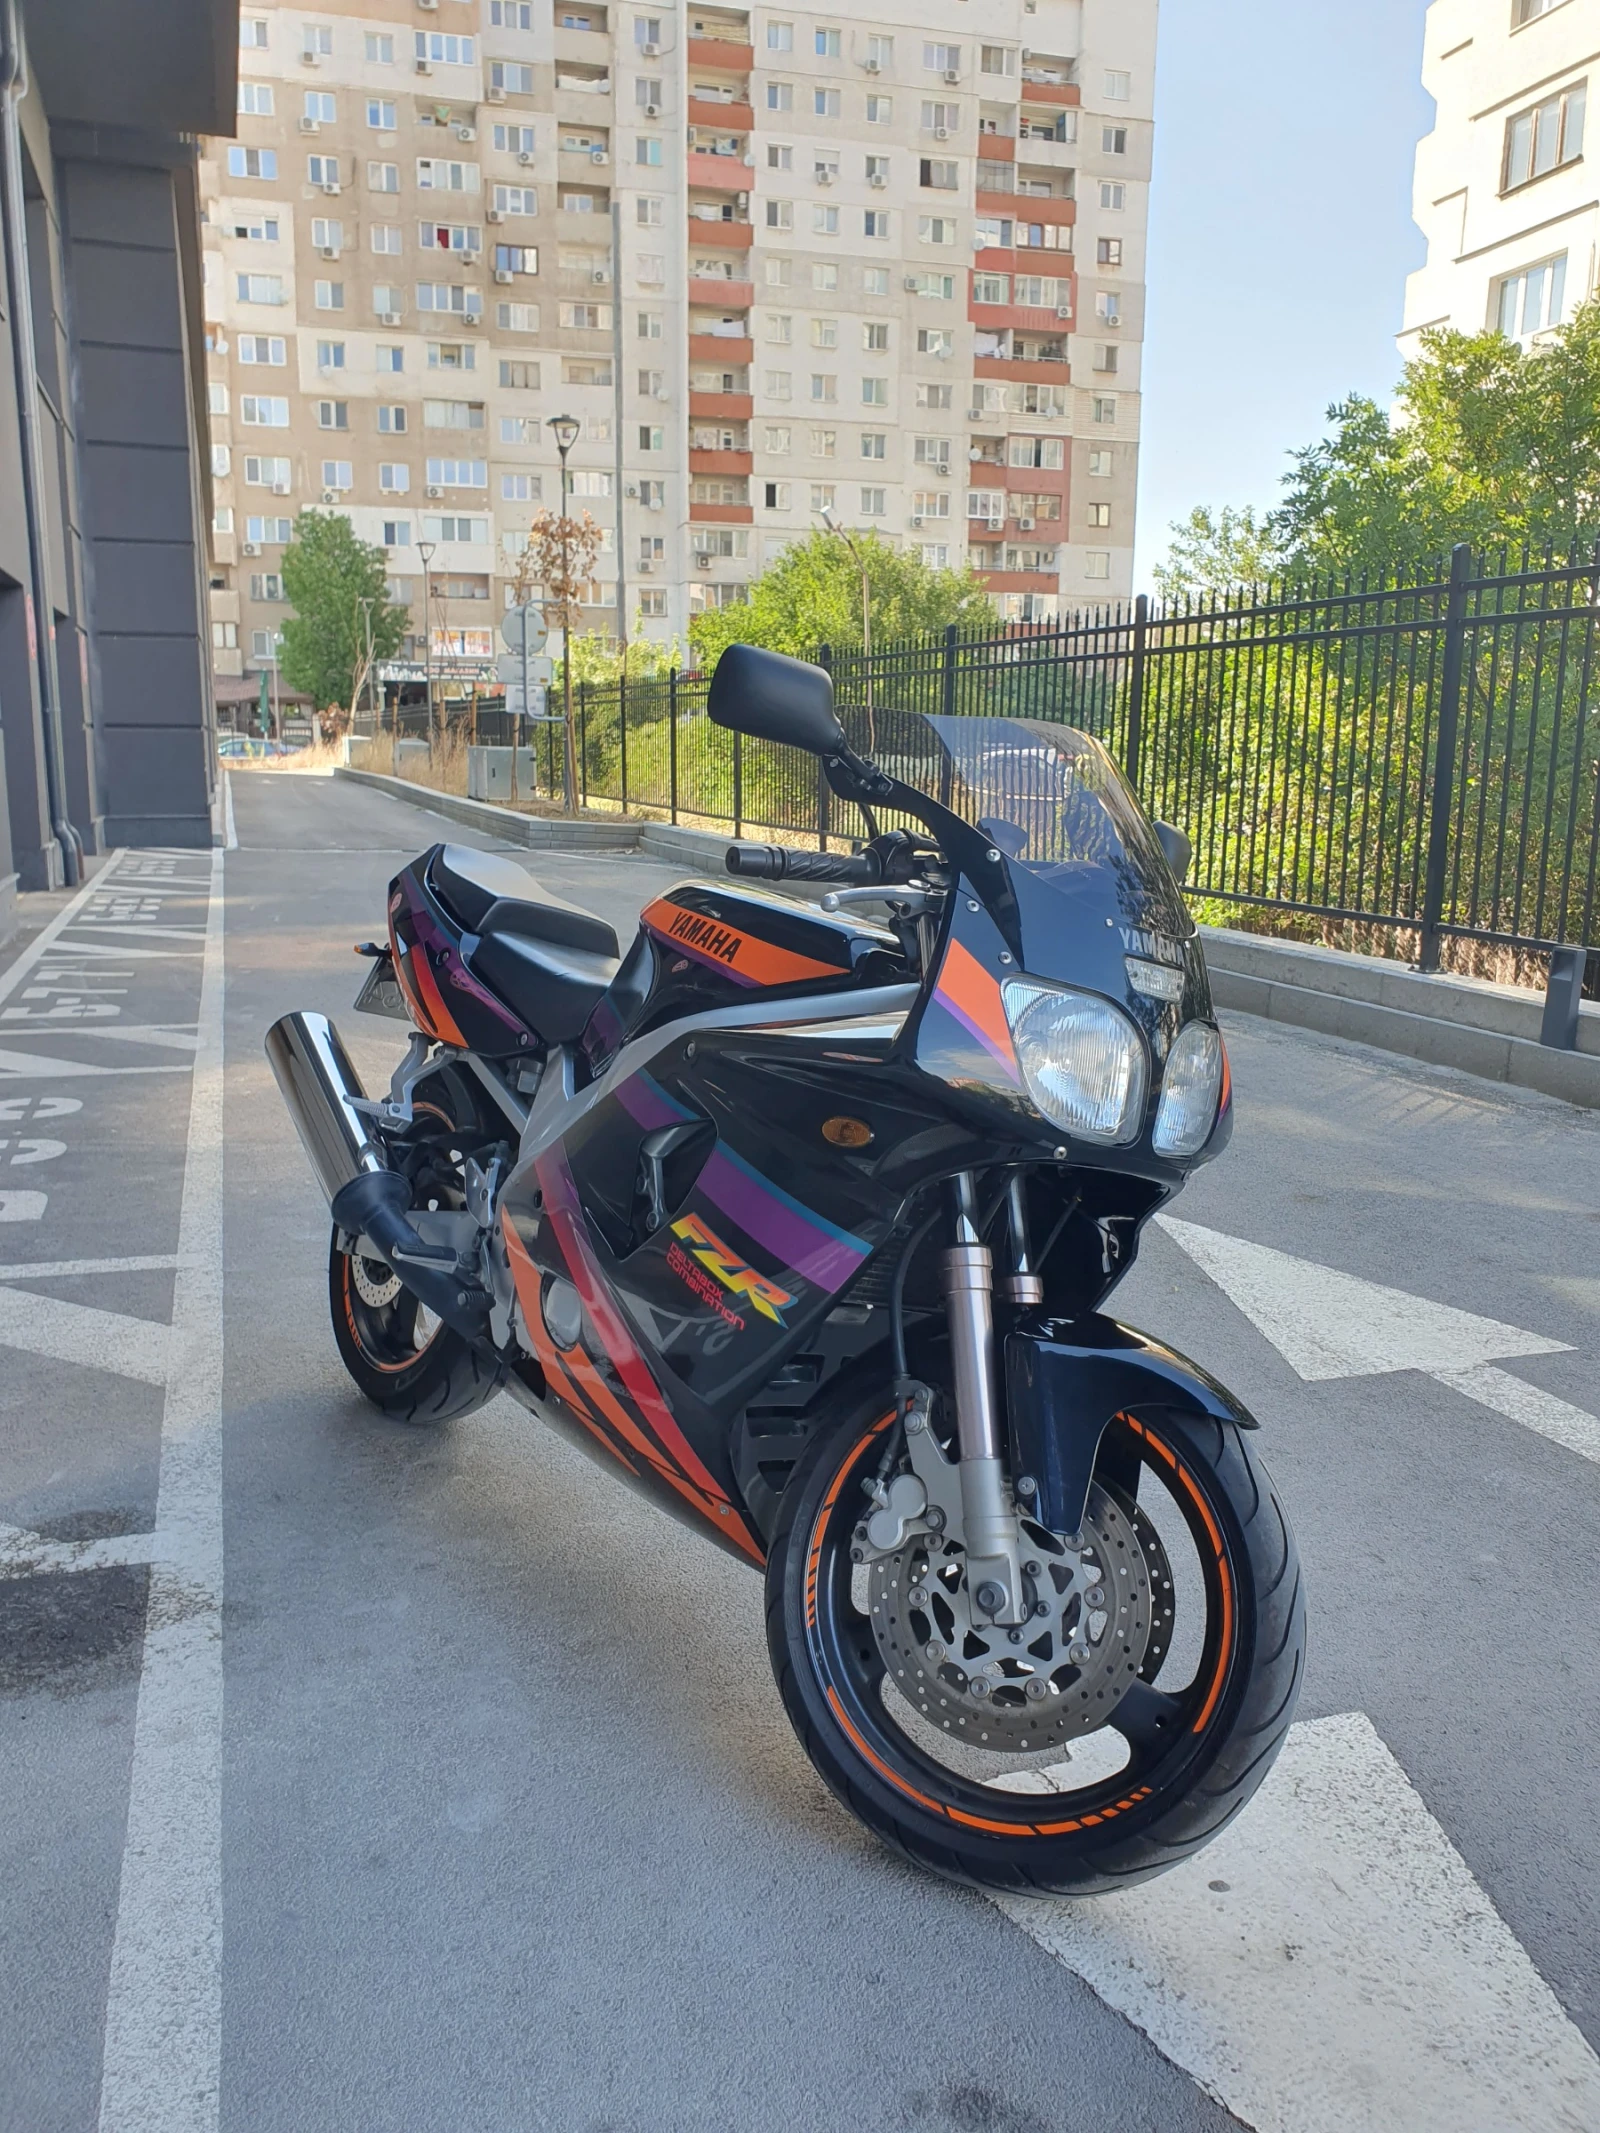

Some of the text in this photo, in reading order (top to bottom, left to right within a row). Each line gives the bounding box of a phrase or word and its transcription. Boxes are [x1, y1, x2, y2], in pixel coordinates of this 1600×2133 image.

[668, 911, 743, 963] YAMAHA
[1118, 926, 1186, 968] YAMAHA
[665, 1253, 746, 1332] COMBINATION
[669, 1211, 799, 1329] FZR
[669, 1241, 725, 1300] DELTABOX
